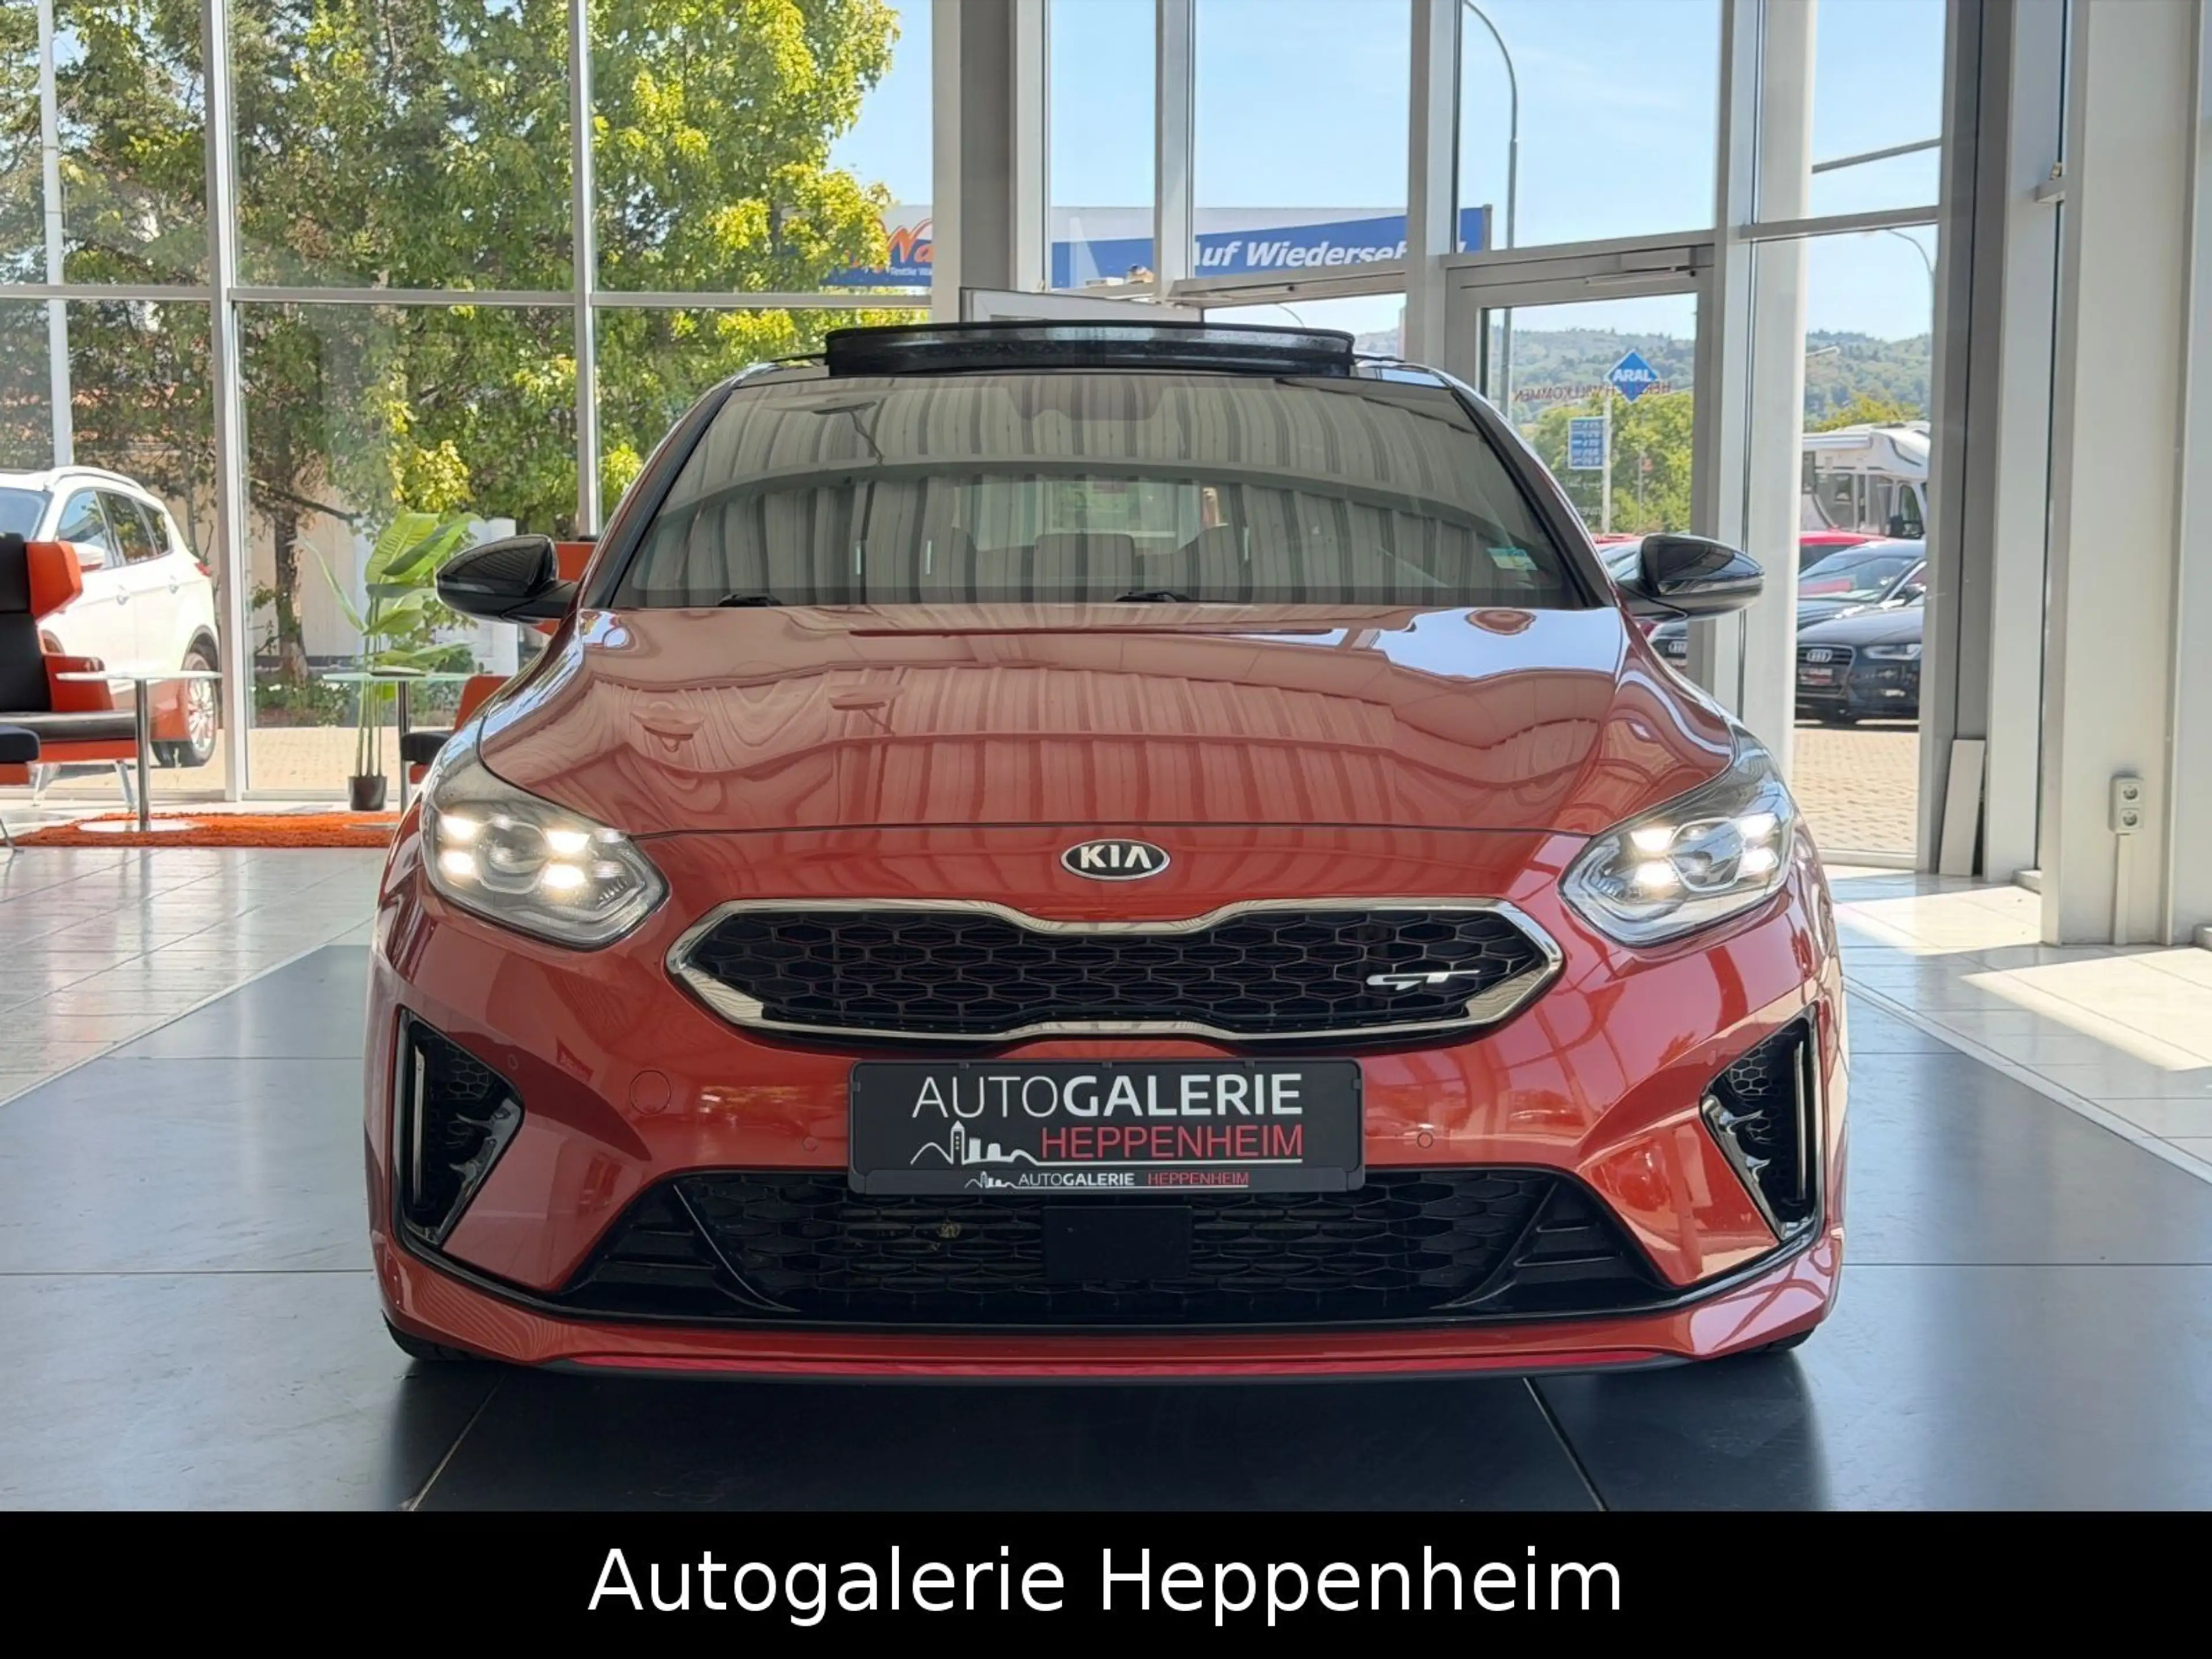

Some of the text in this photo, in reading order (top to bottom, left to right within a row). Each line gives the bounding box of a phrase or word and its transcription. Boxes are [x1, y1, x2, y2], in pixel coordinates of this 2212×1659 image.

[1613, 368, 1652, 382] ARAL
[1081, 844, 1152, 869] KIA
[1366, 969, 1481, 991] GT
[912, 1073, 1303, 1118] AUTOGALERIE
[1042, 1124, 1303, 1159] HEPPENHEIM
[1018, 1172, 1249, 1186] AUTOGALERIE HEPPENHEIM
